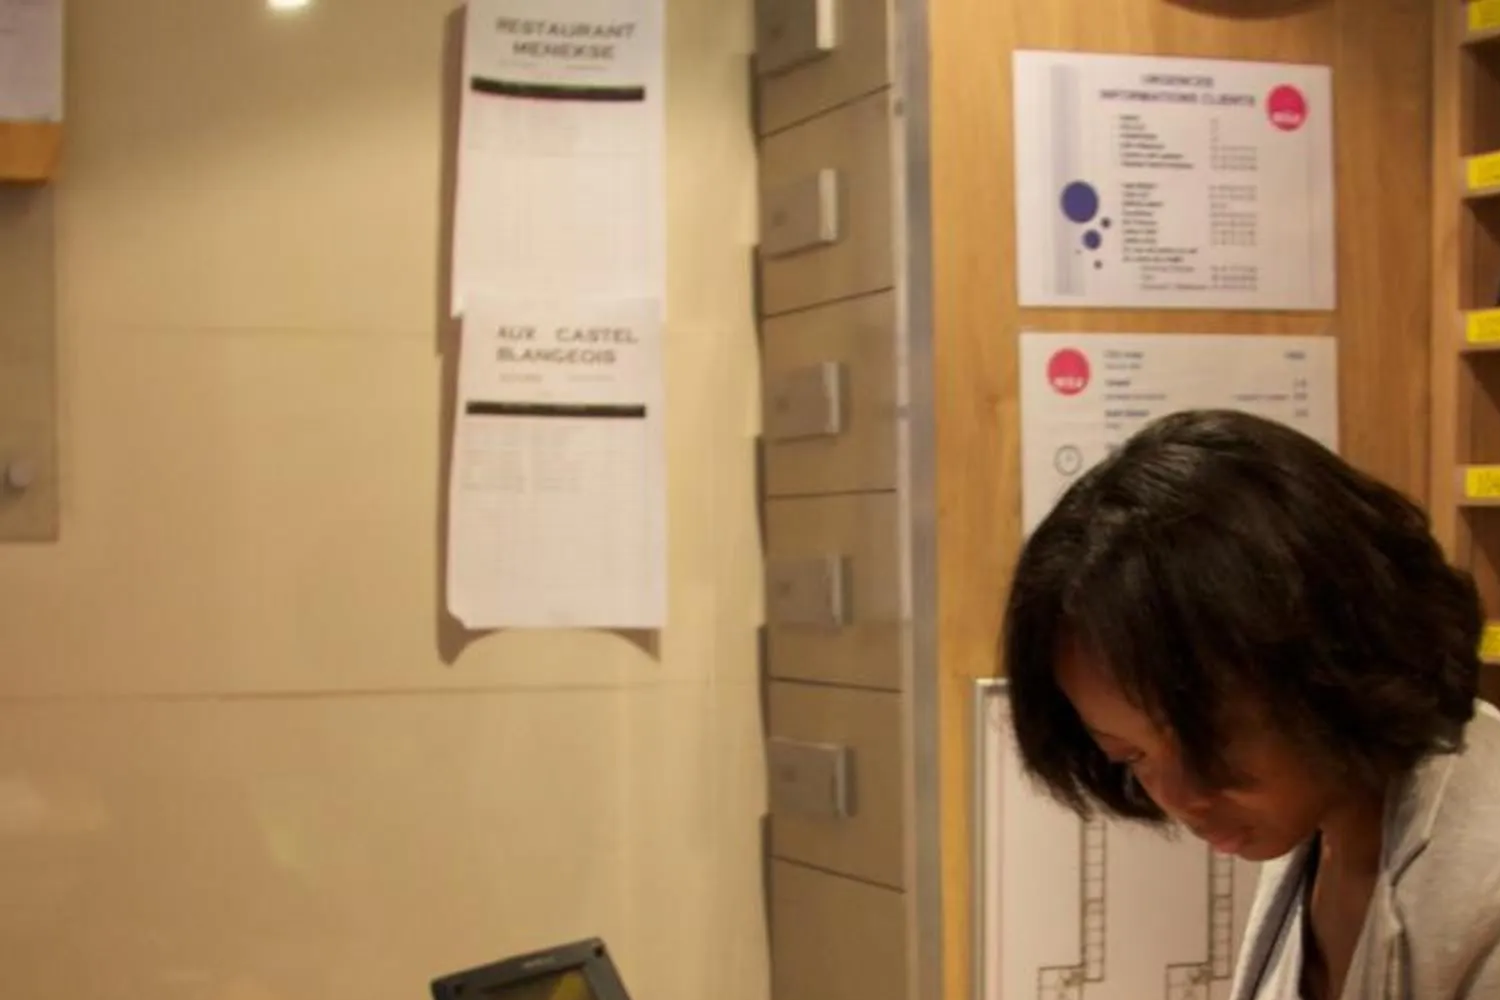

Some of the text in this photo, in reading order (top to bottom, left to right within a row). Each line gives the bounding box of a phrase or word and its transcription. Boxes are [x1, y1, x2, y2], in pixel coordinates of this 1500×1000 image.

[496, 17, 636, 39] RESTAURANT
[498, 325, 639, 344] AUX CASTEL
